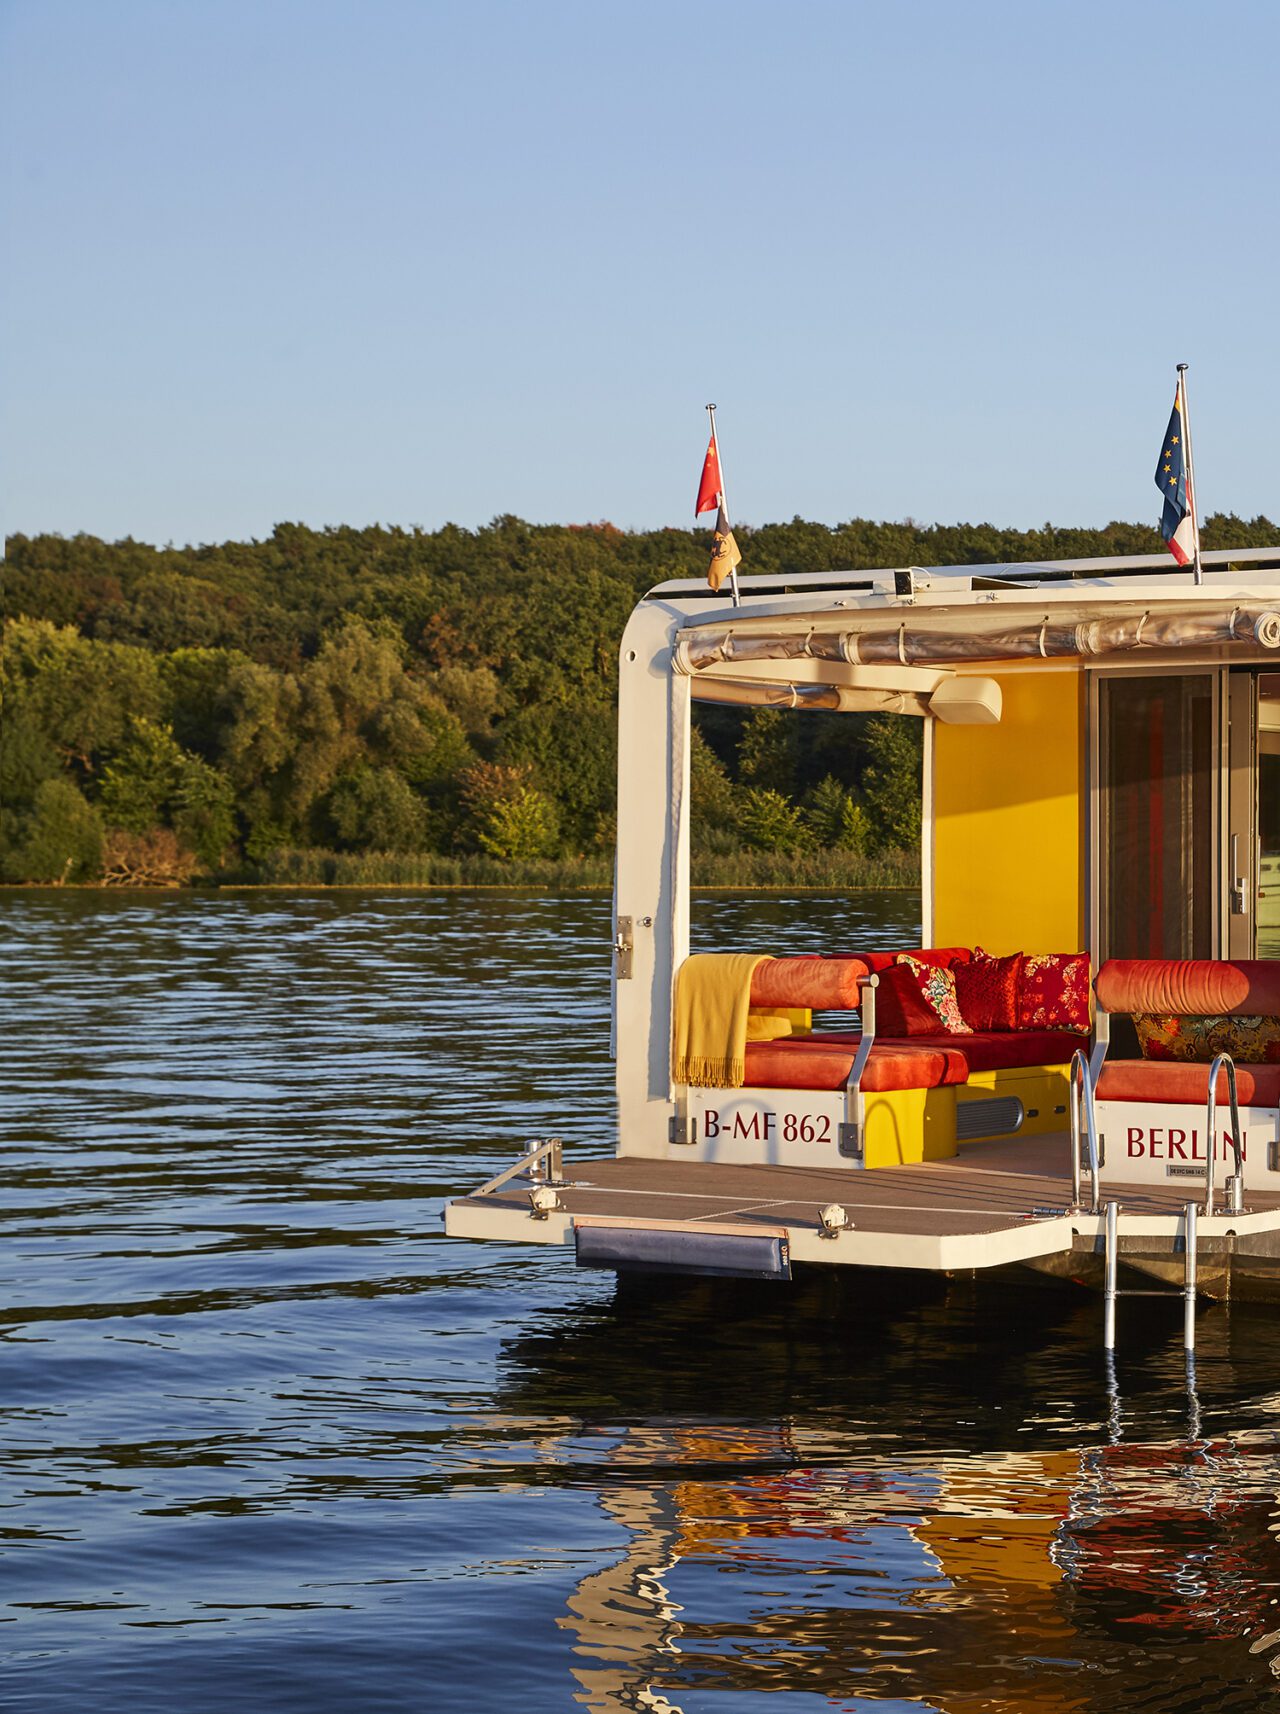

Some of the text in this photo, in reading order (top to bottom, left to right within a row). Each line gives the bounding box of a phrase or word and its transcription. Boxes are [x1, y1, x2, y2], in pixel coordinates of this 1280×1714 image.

[704, 1109, 831, 1143] B-MF 862
[1127, 1127, 1247, 1162] BERLIN
